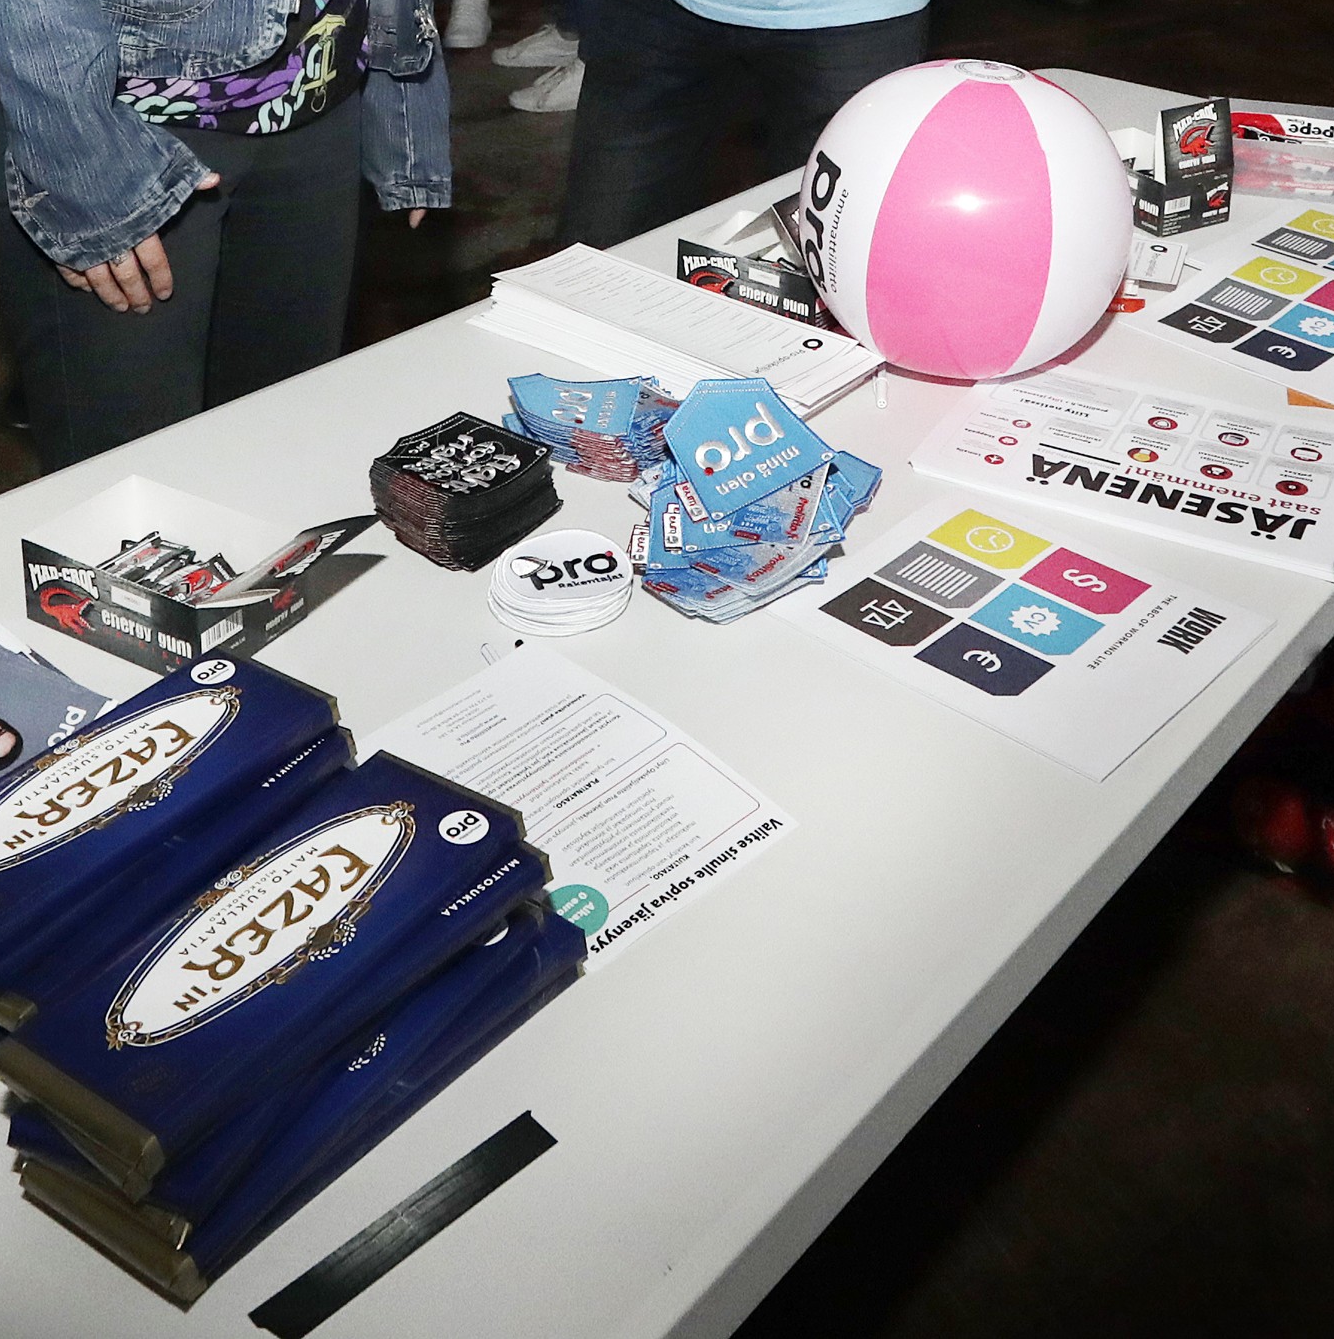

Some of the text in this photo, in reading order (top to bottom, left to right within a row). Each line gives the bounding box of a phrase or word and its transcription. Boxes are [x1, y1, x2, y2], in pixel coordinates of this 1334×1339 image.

[1173, 103, 1217, 140] MAD-CROC
[805, 150, 841, 292] pro
[827, 189, 849, 294] ammattiliitto
[682, 255, 739, 279] MAD-CROC
[739, 283, 809, 317] energy gum
[1018, 398, 1089, 417] Liity netissä!
[690, 400, 785, 478] pro
[714, 445, 801, 496] minä olen
[1124, 465, 1322, 515] saat enemmän!
[1024, 453, 1316, 540] JÄSENENÄ
[27, 562, 100, 600] MAD-CROC
[558, 573, 624, 588] Rakentajat
[101, 609, 153, 643] energy
[157, 632, 192, 659] gum
[1086, 594, 1177, 669] THE ABC OF WORKING LIFE
[1157, 606, 1227, 655] WORK
[196, 656, 228, 682] pro
[12, 719, 149, 809] MAITO SUKLAATIA
[445, 810, 481, 838] pro
[439, 857, 519, 918] MAITOSUKLAA
[582, 817, 783, 954] Valitse sinulle sopiva jäsenyys
[648, 853, 690, 881] KULTATASO,
[177, 844, 318, 959] MAITO SUKLAATIA
